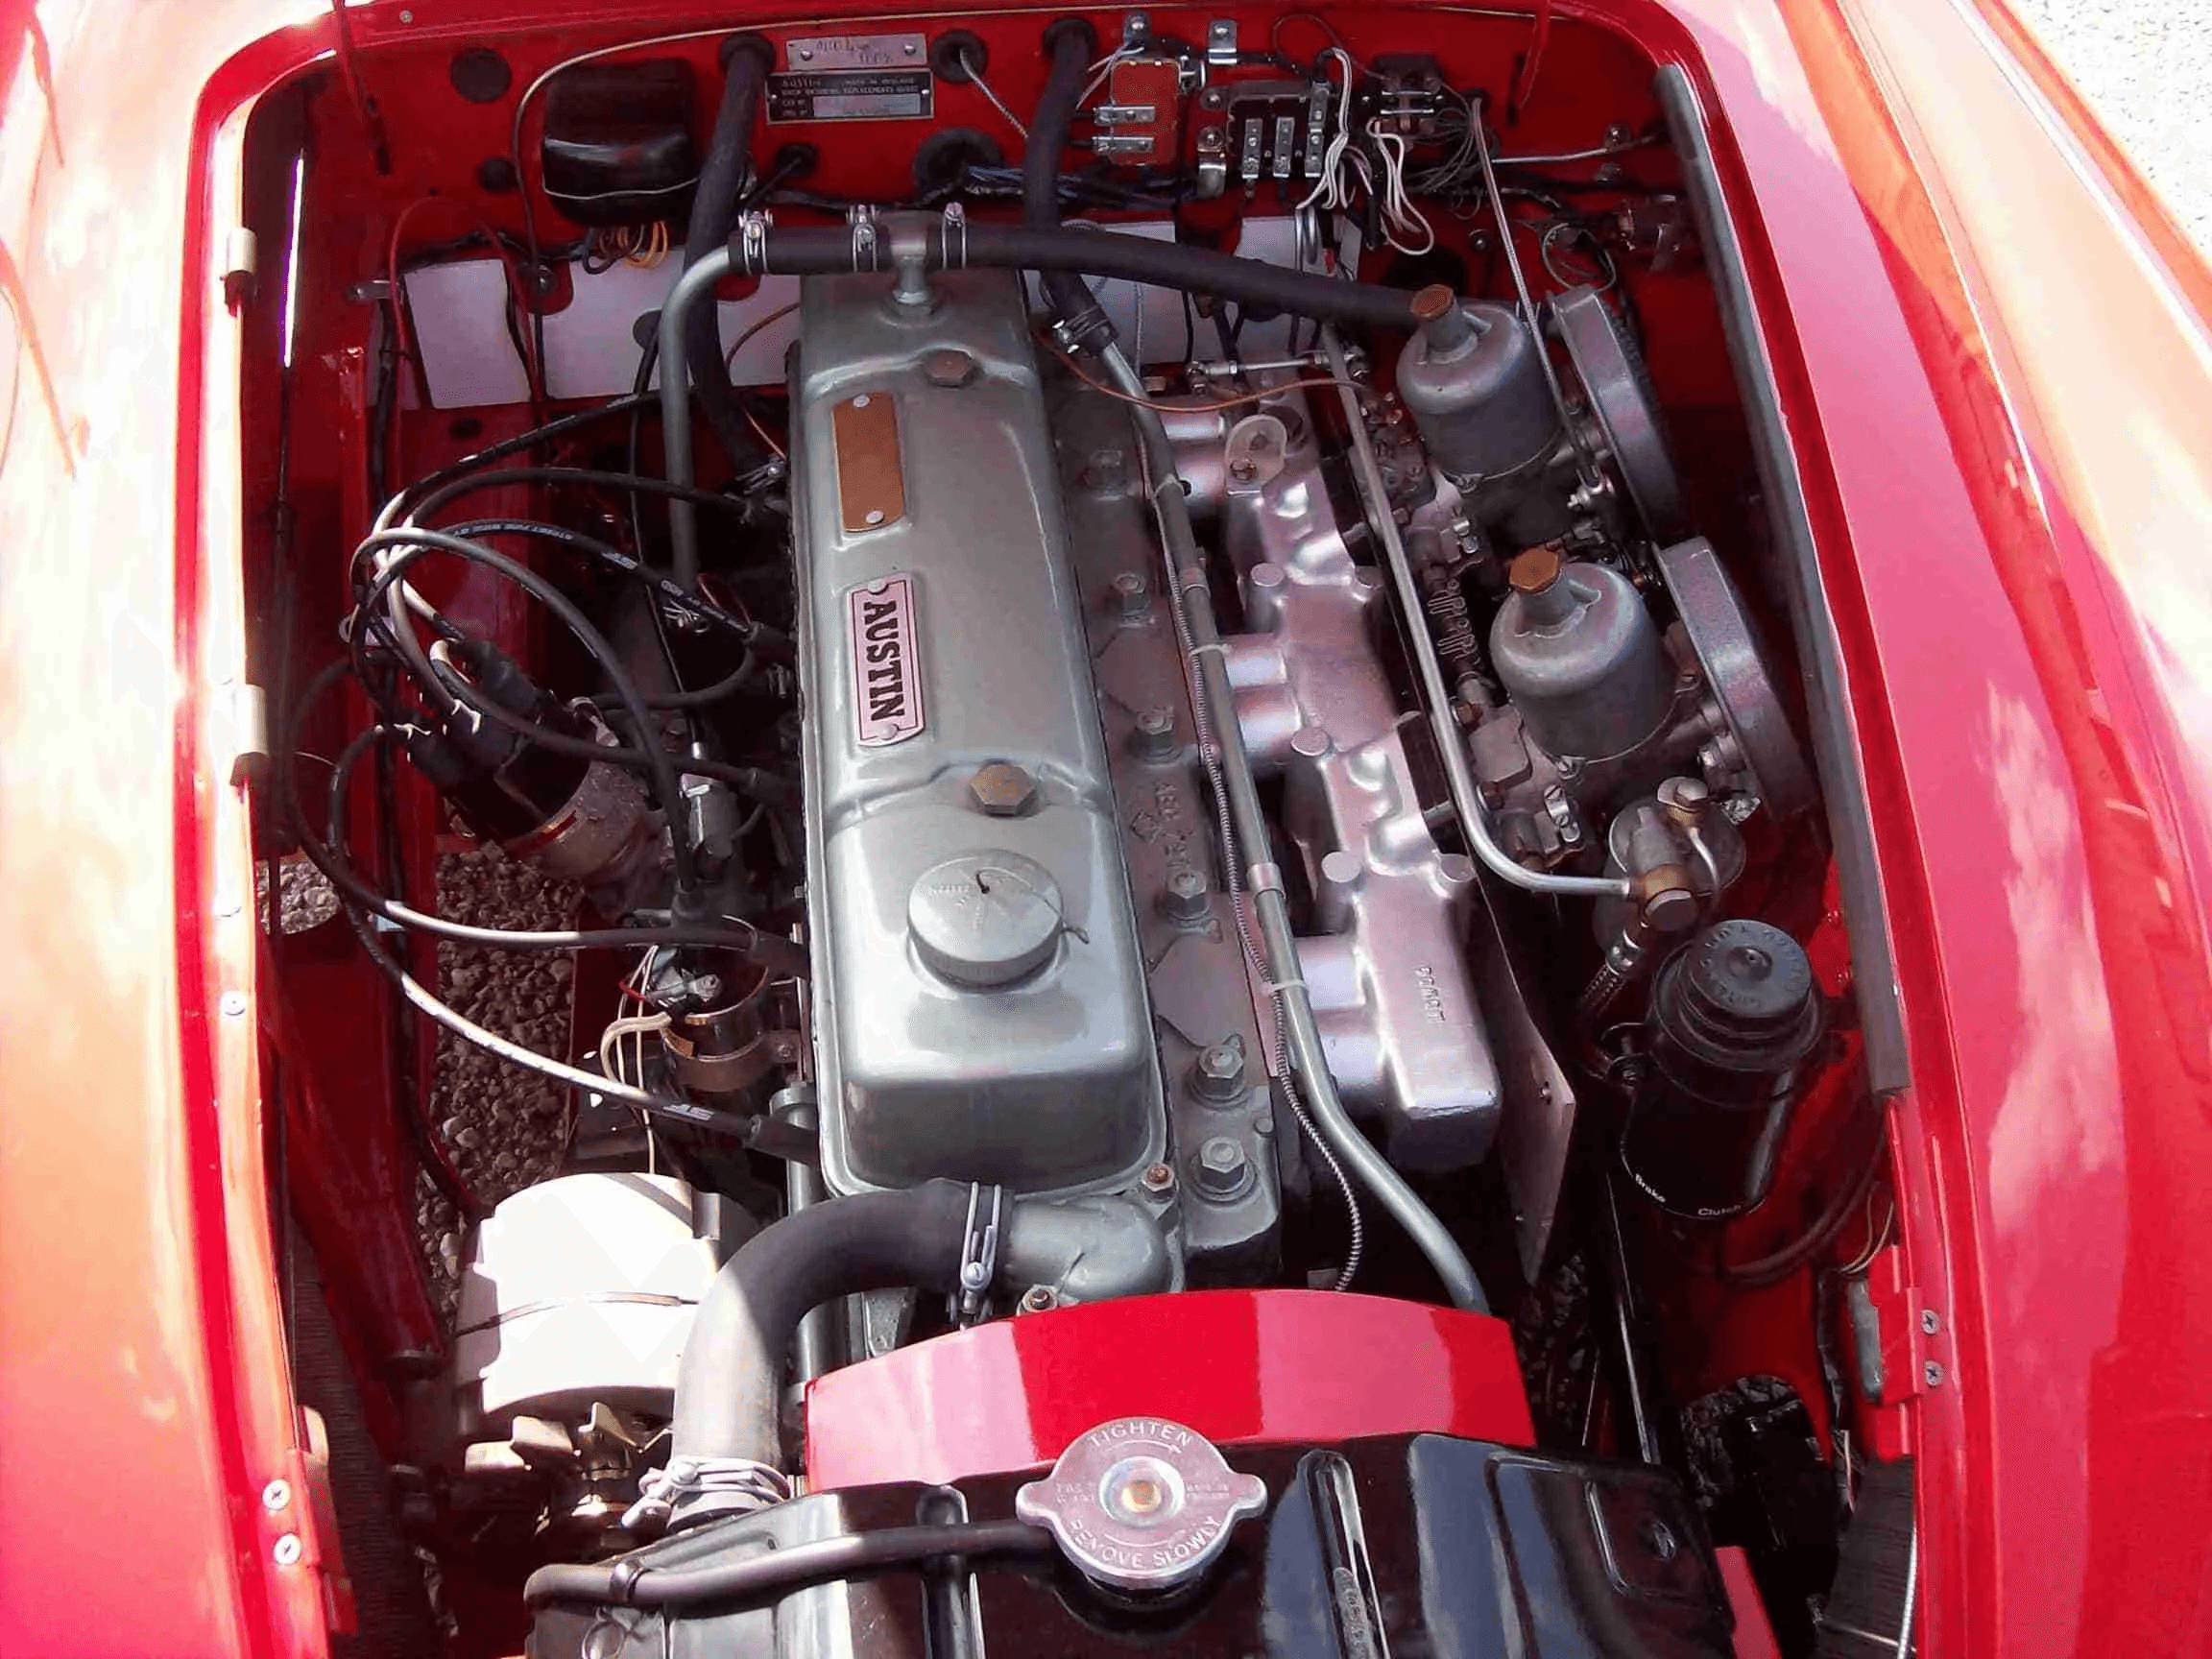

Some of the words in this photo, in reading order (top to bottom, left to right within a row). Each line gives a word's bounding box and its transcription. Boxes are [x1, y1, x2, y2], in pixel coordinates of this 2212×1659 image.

[864, 600, 905, 721] AUSTIN
[1635, 1173, 1666, 1203] Brake
[1087, 1421, 1195, 1448] TIGHTEN
